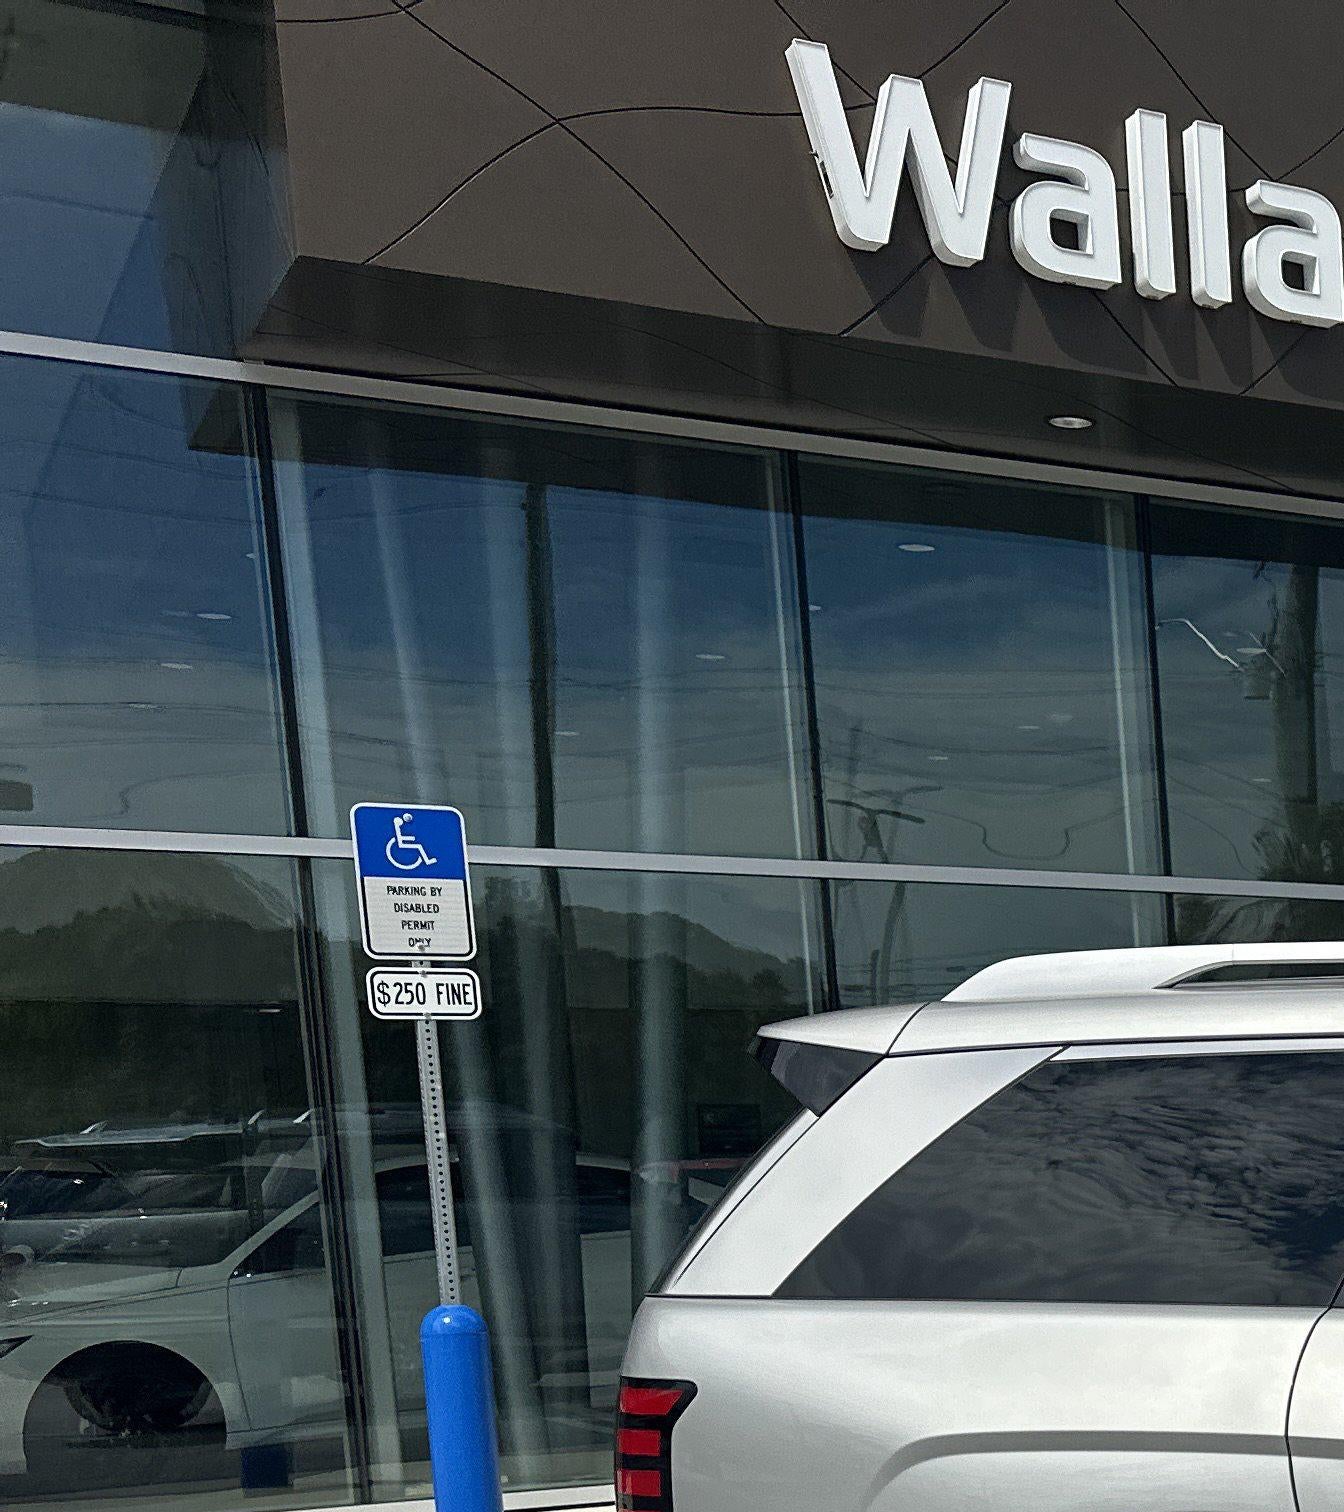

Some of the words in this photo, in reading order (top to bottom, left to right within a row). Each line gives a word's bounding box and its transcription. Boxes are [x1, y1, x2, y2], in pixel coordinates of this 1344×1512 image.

[387, 885, 427, 896] PARKING
[430, 886, 442, 896] BY
[394, 902, 440, 913] DISABLED
[401, 919, 435, 930] PERMIT
[377, 980, 427, 1007] $250
[435, 982, 473, 1006] FINE
